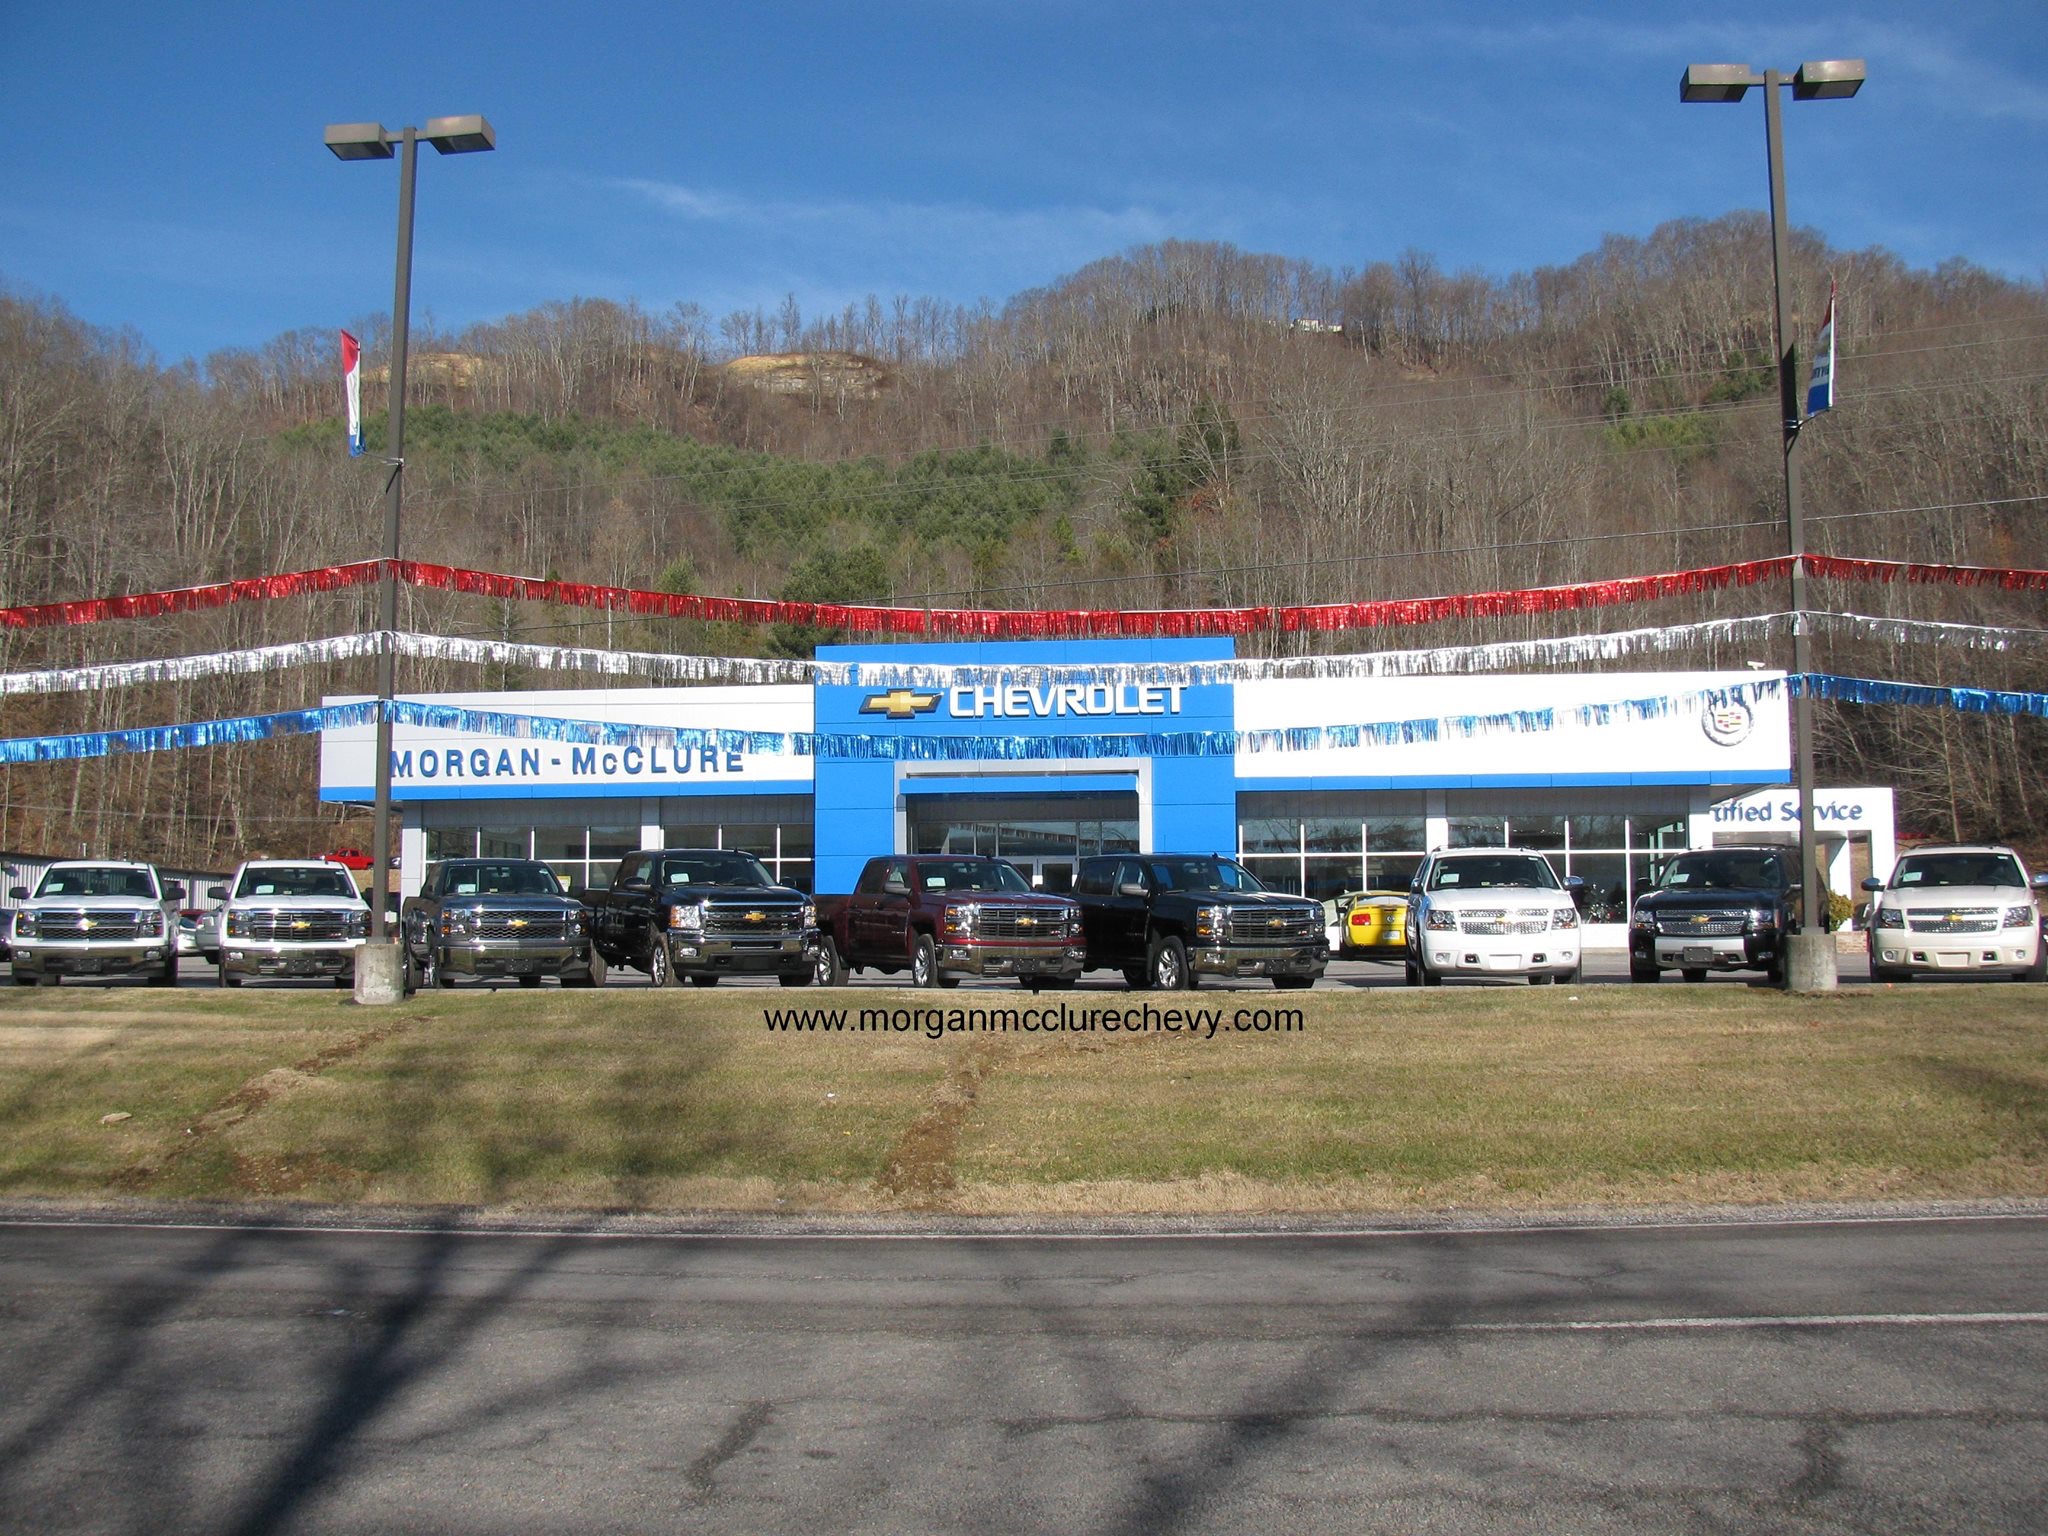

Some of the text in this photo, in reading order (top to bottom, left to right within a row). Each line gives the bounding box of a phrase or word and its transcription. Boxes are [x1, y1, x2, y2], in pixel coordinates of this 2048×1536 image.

[950, 684, 1187, 718] CHEVROLET
[1711, 799, 1862, 822] tified Sevice
